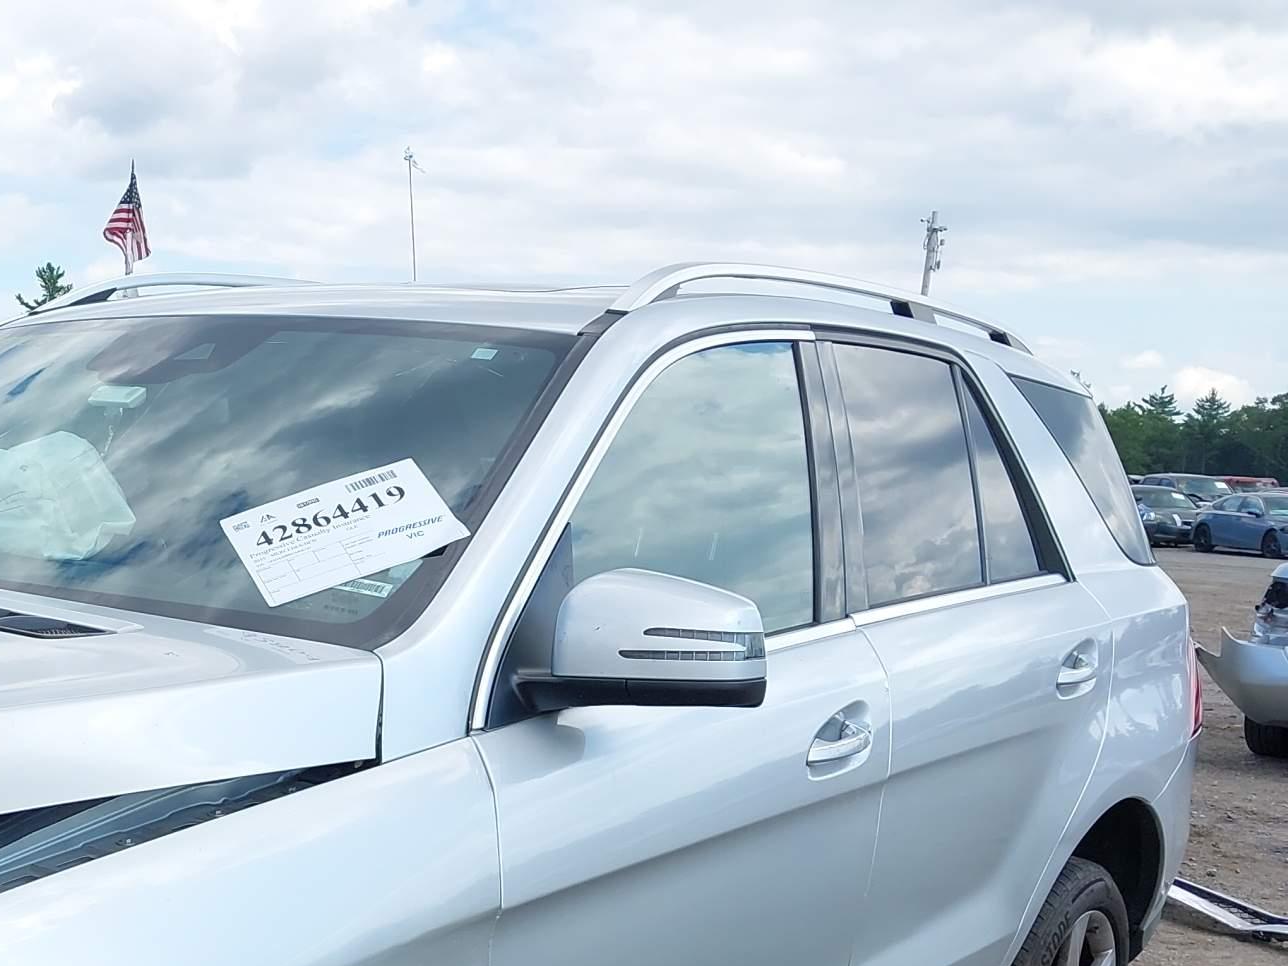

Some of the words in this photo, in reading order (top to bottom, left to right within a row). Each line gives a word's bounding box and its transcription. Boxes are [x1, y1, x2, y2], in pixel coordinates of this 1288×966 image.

[256, 485, 406, 548] 42864419
[377, 515, 444, 539] PROGRESSIVE
[405, 529, 425, 541] VIC
